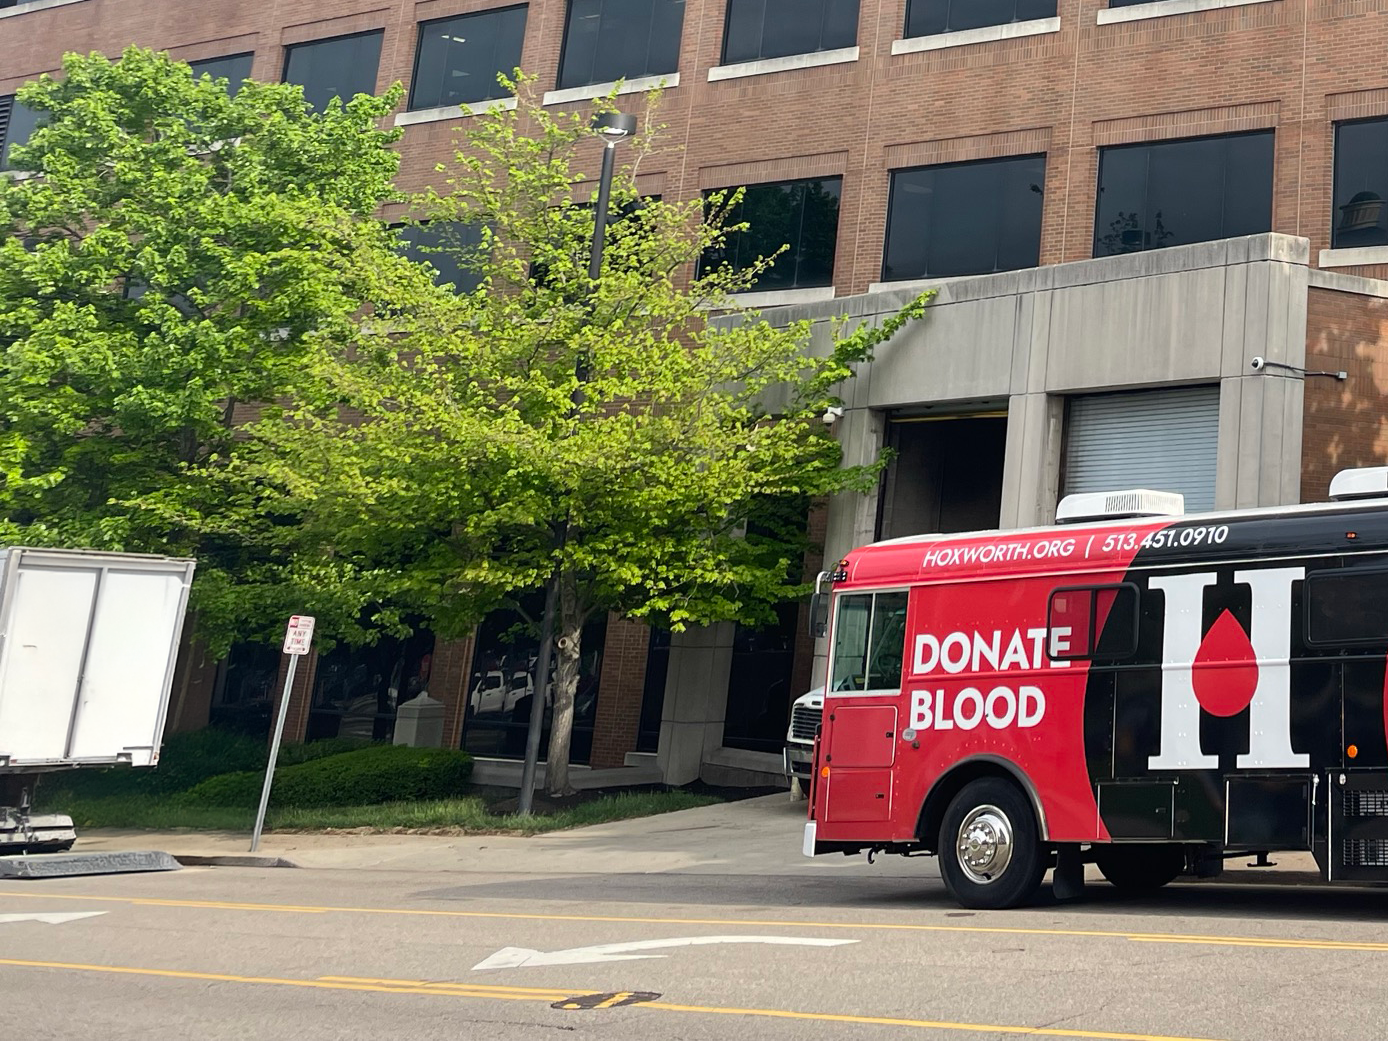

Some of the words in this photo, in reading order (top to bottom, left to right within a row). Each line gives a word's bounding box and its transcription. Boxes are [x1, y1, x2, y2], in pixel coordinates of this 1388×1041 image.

[922, 537, 1076, 569] HOXWORTH.ORG
[1101, 524, 1230, 552] 513.451.0910
[913, 626, 1072, 676] DONATE
[909, 685, 1046, 731] BLOOD
